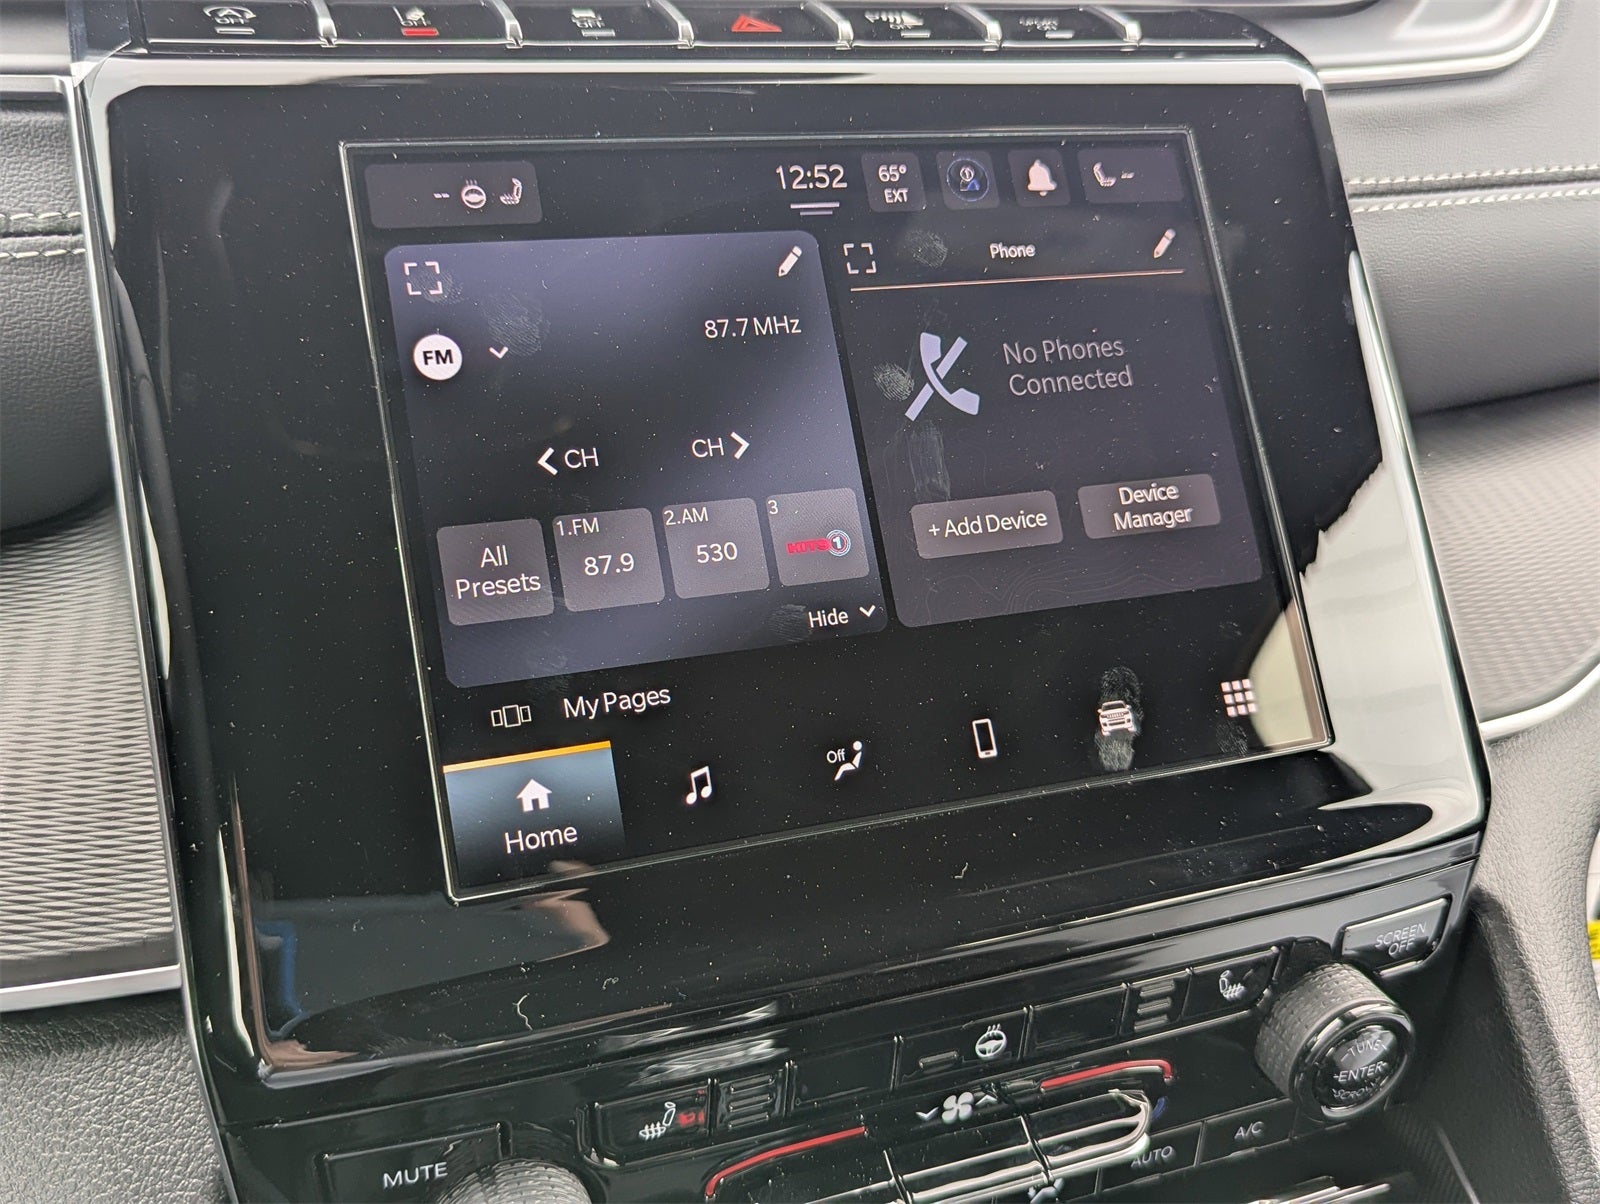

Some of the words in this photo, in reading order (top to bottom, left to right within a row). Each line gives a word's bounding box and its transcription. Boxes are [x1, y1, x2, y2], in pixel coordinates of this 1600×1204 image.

[775, 163, 848, 191] 12:52
[878, 164, 908, 182] 65°
[884, 187, 909, 204] EXT
[989, 242, 1036, 260] Phone
[704, 317, 749, 339] 87.7
[753, 315, 802, 336] MHz
[422, 348, 455, 367] FM
[1002, 342, 1037, 365] No
[1043, 339, 1125, 363] Phones
[1008, 365, 1134, 397] Connected
[564, 448, 600, 470] CH
[691, 438, 724, 458] CH
[1118, 482, 1180, 505] Device
[664, 507, 709, 526] 2.AM
[767, 499, 779, 515] 3
[556, 517, 600, 537] 1.FM
[944, 515, 983, 538] Add
[986, 509, 1048, 534] Device
[1113, 507, 1193, 532] Manager
[480, 545, 509, 569] All
[696, 541, 738, 564] 530
[584, 552, 635, 577] 87.9
[455, 573, 542, 600] Presets
[808, 607, 849, 629] Hide
[564, 698, 599, 721] My
[604, 687, 671, 714] Pages
[826, 747, 846, 764] Off
[504, 825, 578, 854] Home
[1374, 921, 1428, 949] SCREEN
[1388, 937, 1416, 956] OFF
[1346, 1039, 1383, 1057] TUNE
[1337, 1060, 1384, 1082] ENTER
[1234, 1120, 1264, 1140] A/C
[1130, 1145, 1174, 1169] AUTO
[382, 1161, 449, 1189] MUTE
